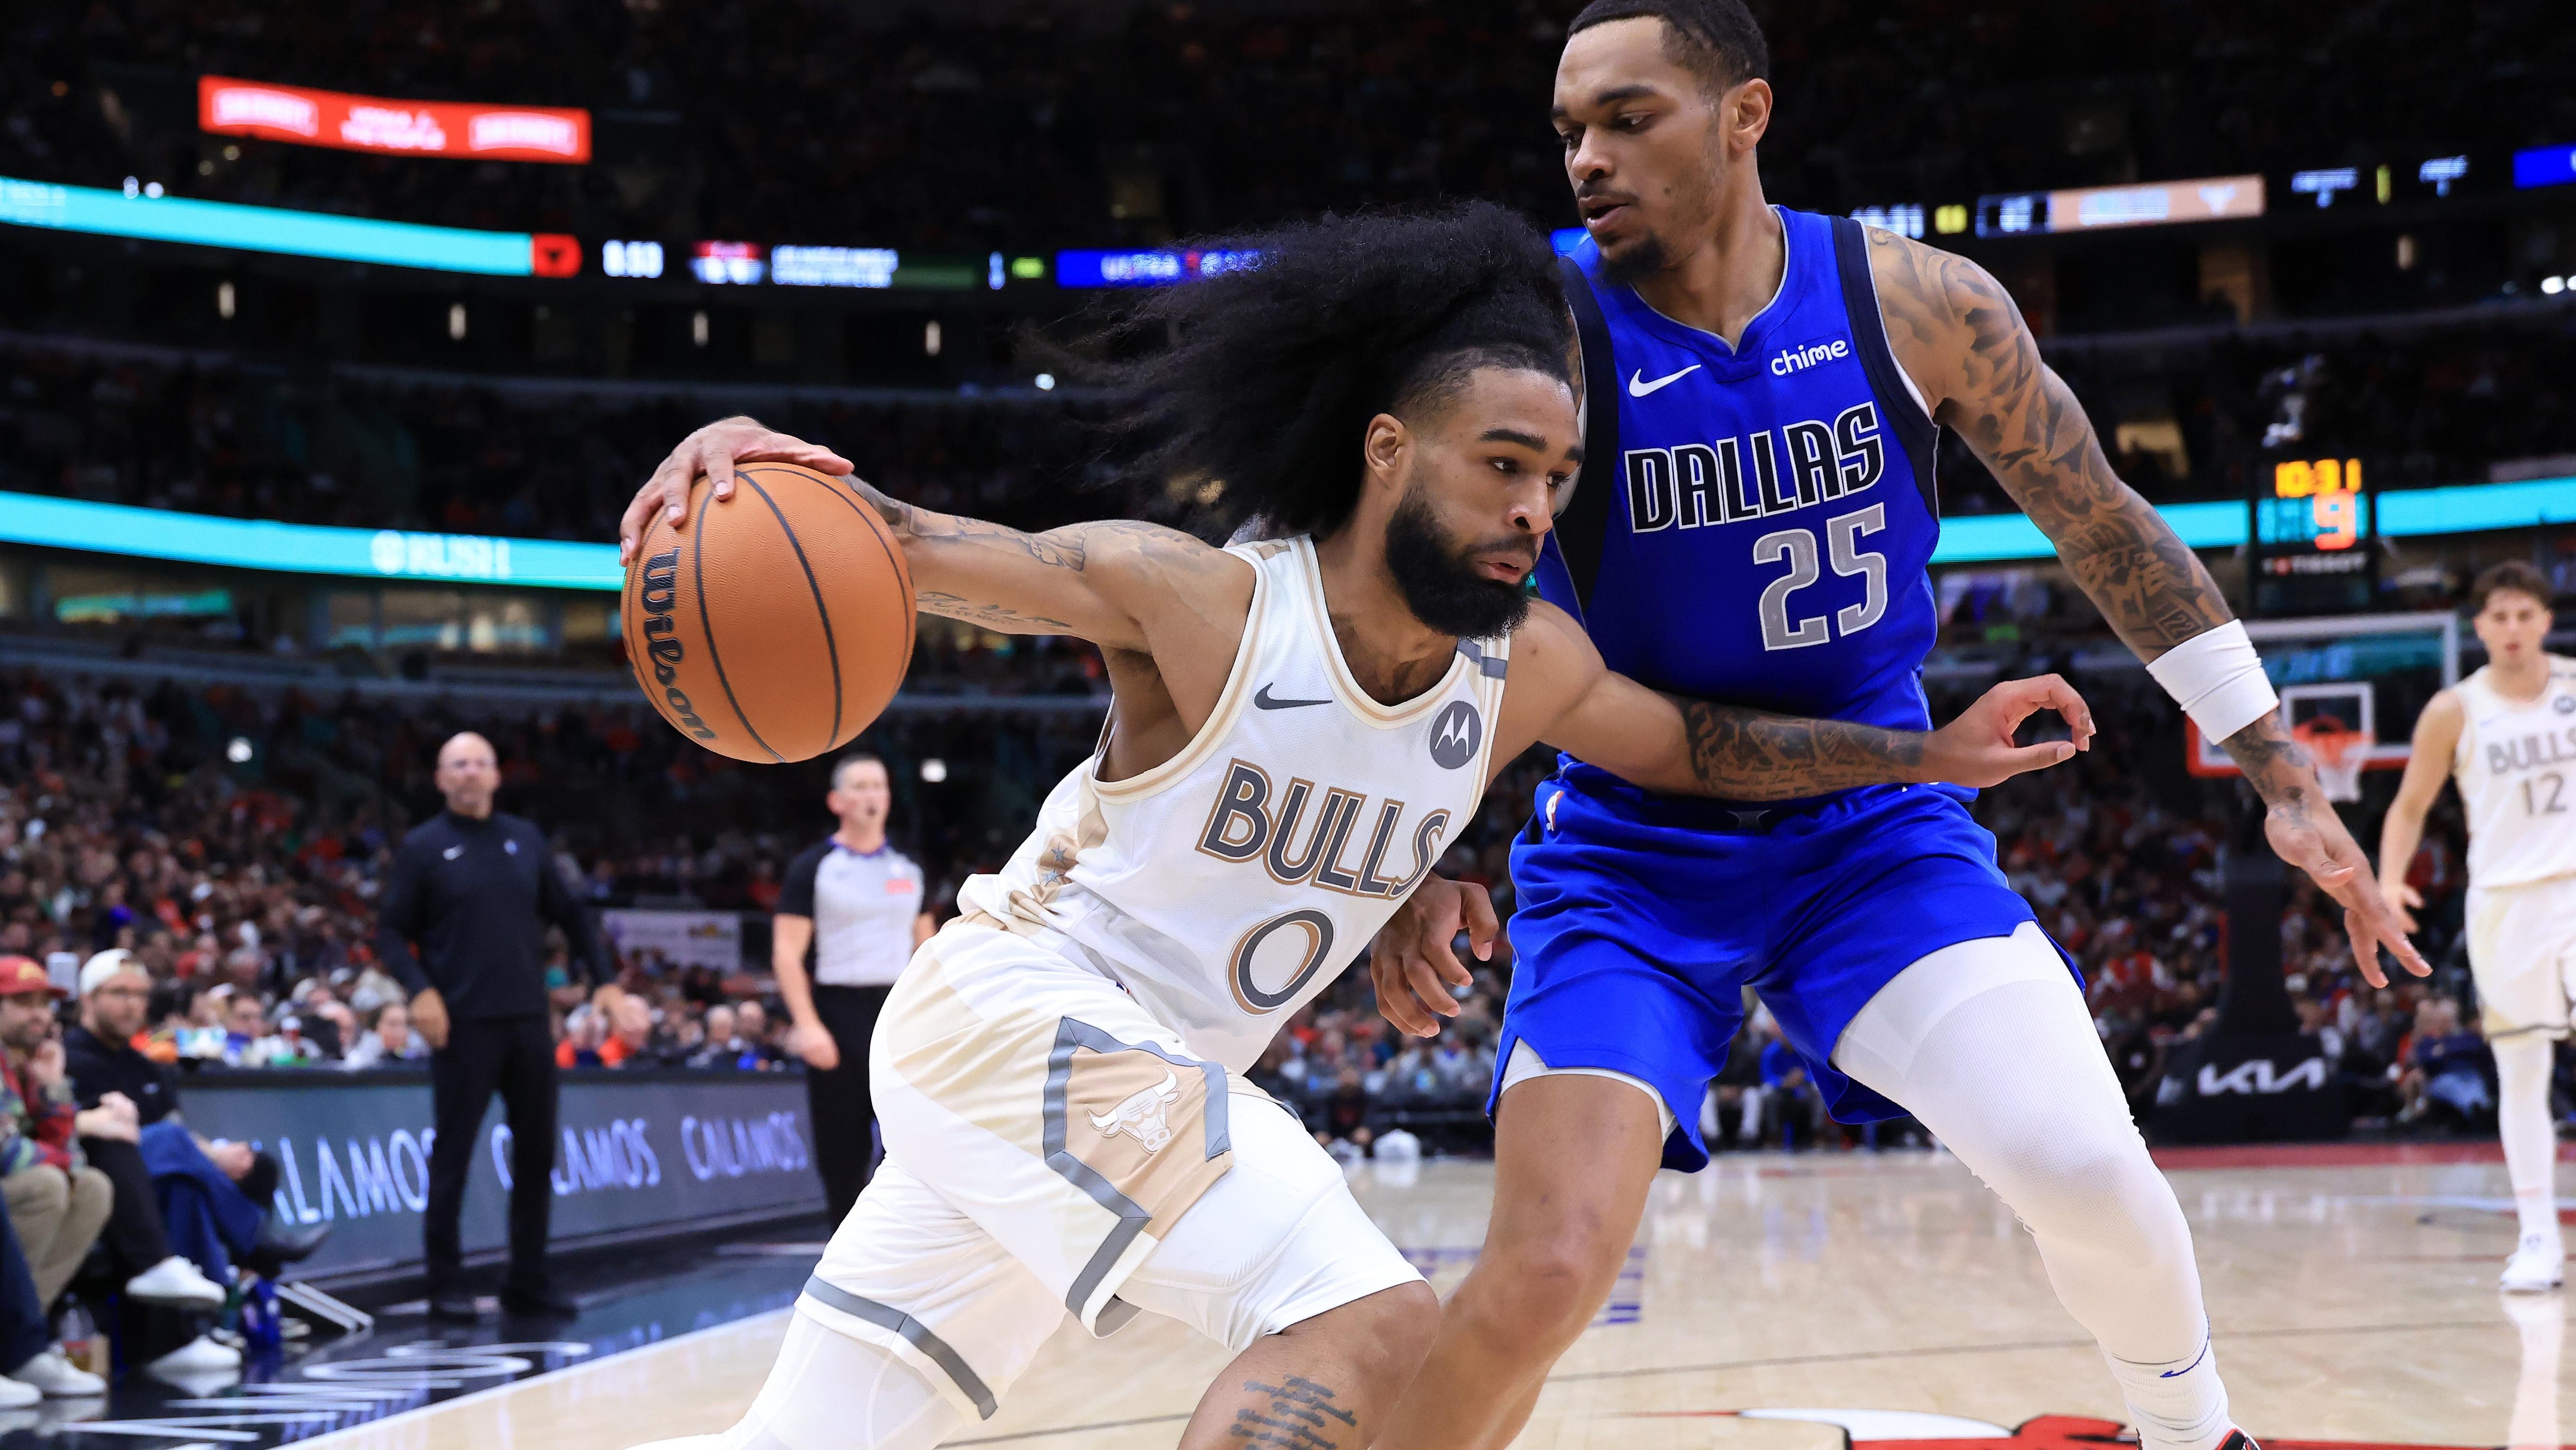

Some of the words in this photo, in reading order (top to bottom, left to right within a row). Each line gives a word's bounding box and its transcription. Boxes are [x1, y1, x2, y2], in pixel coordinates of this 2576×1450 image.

[1771, 339, 1849, 377] chime
[1624, 400, 1885, 534] DALLAS
[2313, 487, 2357, 551] 9
[1753, 502, 1888, 651] 25
[641, 546, 719, 740] Wilson
[1195, 757, 1451, 901] BULLS
[2522, 772, 2567, 817] 12
[1225, 907, 1337, 1018] 0
